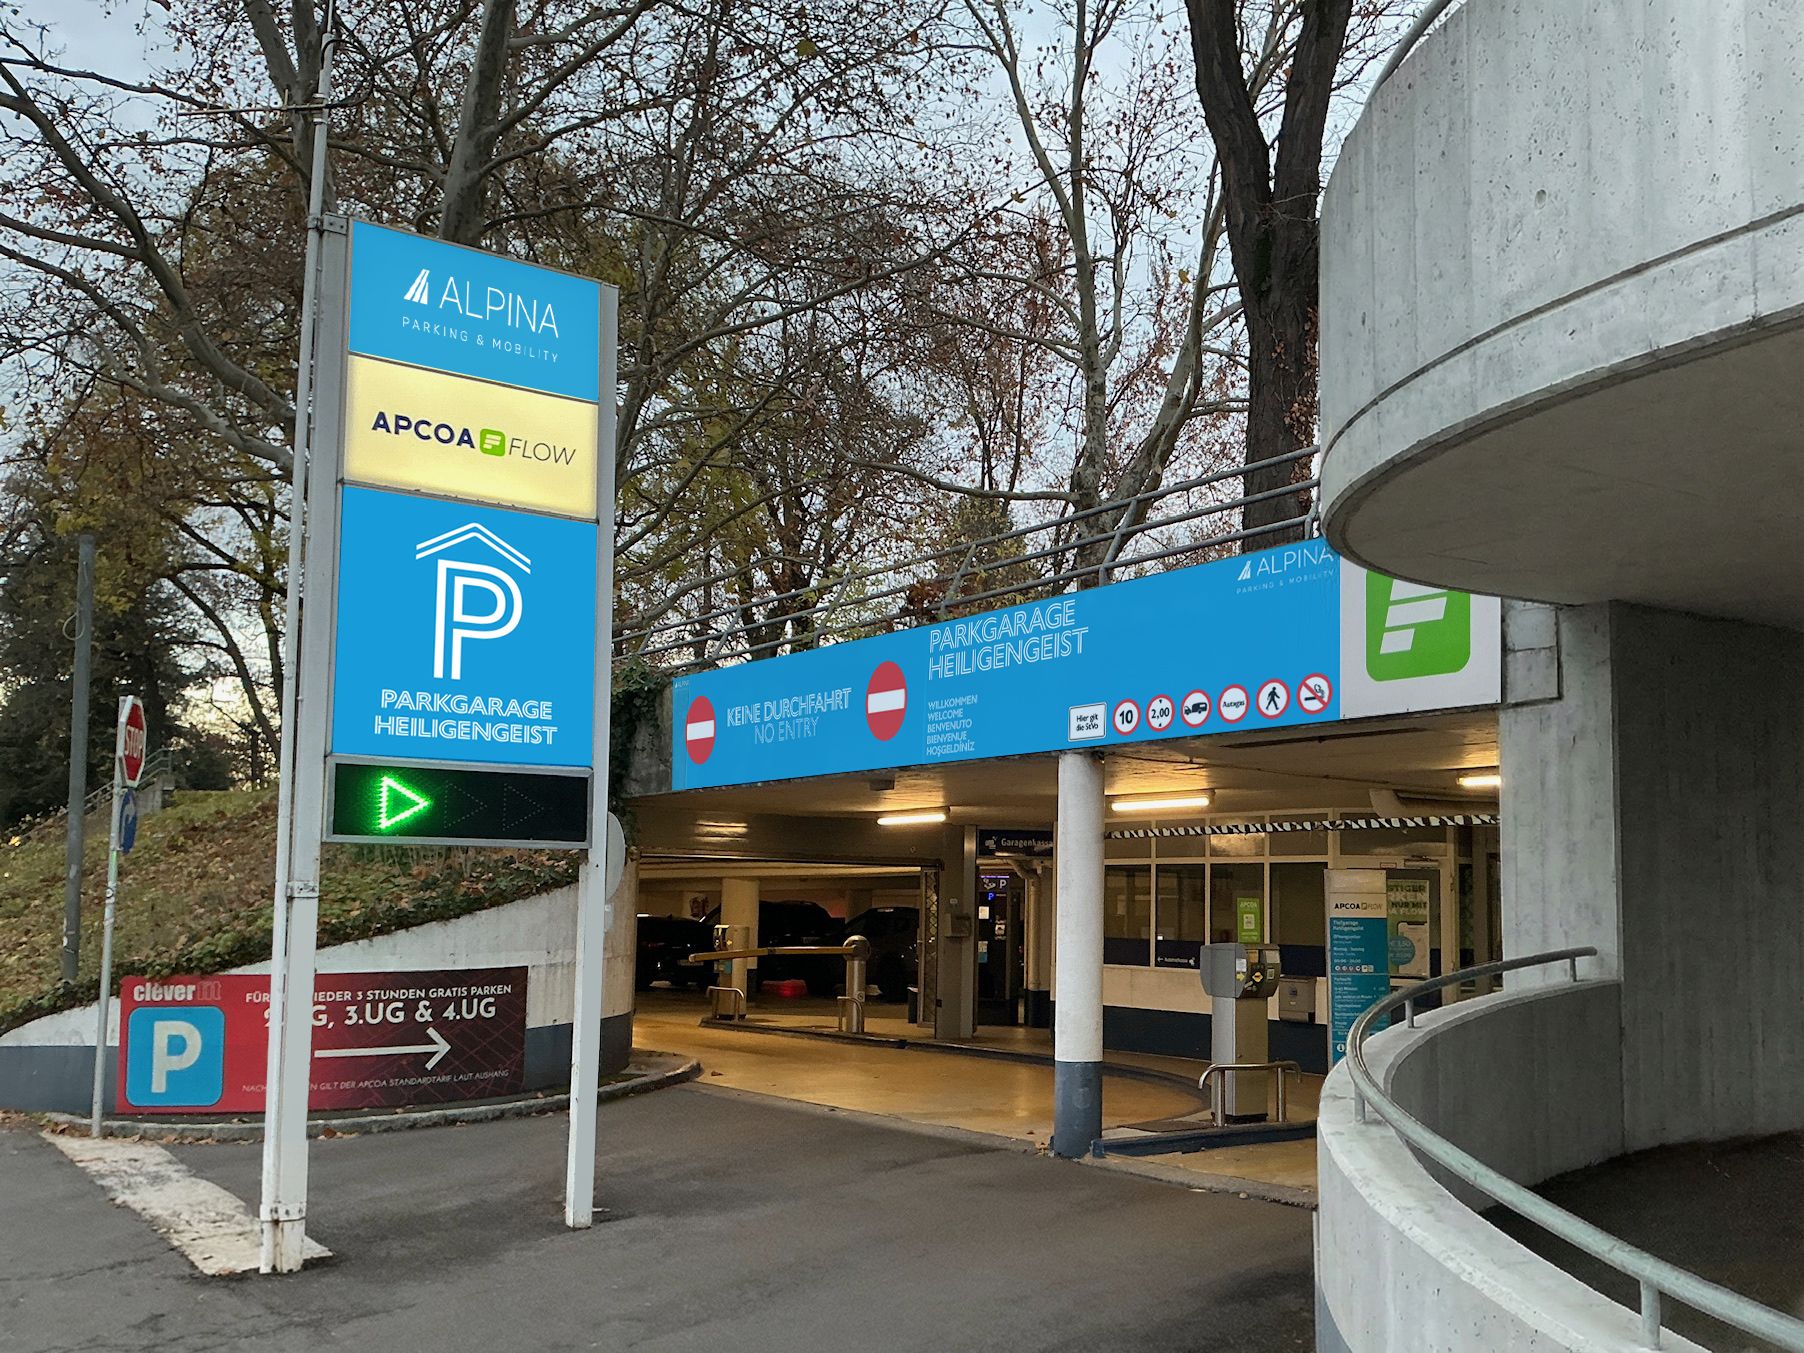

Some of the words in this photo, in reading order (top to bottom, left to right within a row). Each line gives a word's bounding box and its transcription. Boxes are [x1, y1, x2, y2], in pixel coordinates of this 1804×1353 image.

[439, 276, 559, 338] ALPINA
[402, 316, 468, 342] PARKING
[476, 334, 484, 346] &
[492, 338, 559, 363] MOBILITY
[371, 411, 476, 449] APCOA
[508, 437, 576, 466] FLOW
[1257, 545, 1334, 576] ALPINA
[929, 599, 1076, 653] PARKGARAGE
[928, 626, 1089, 681] HEILIGENGEIST
[381, 689, 553, 720] PARKGARAGE
[727, 702, 761, 727] KEINE
[763, 687, 852, 722] DURCHFAHRT
[927, 694, 978, 710] WILLKOMMEN
[927, 708, 964, 722] WELCOME
[1151, 707, 1170, 720] 2,00
[374, 715, 558, 745] HEILIGENGEIST
[754, 723, 775, 745] NO
[778, 716, 820, 742] ENTRY
[927, 718, 973, 733] BENVENUTO
[1076, 723, 1085, 731] die
[1119, 709, 1133, 725] 10
[124, 725, 143, 758] STOP
[926, 730, 967, 745] BIENVENUE
[1334, 902, 1360, 910] APCOA
[245, 991, 270, 1003] FÜR
[357, 991, 363, 1000] 3
[366, 988, 425, 1000] STUNDEN
[428, 986, 468, 998] GRATIS
[470, 984, 512, 996] PARKEN
[344, 1001, 405, 1026] 3.UG
[414, 1000, 433, 1023] &
[442, 997, 497, 1021] 4.UG
[151, 1020, 202, 1093] P
[319, 1082, 339, 1090] GILT
[358, 1080, 387, 1089] APCOA
[389, 1074, 451, 1087] STANDARDTARIF
[453, 1072, 475, 1082] LAUT
[475, 1069, 510, 1079] AUSHANG
